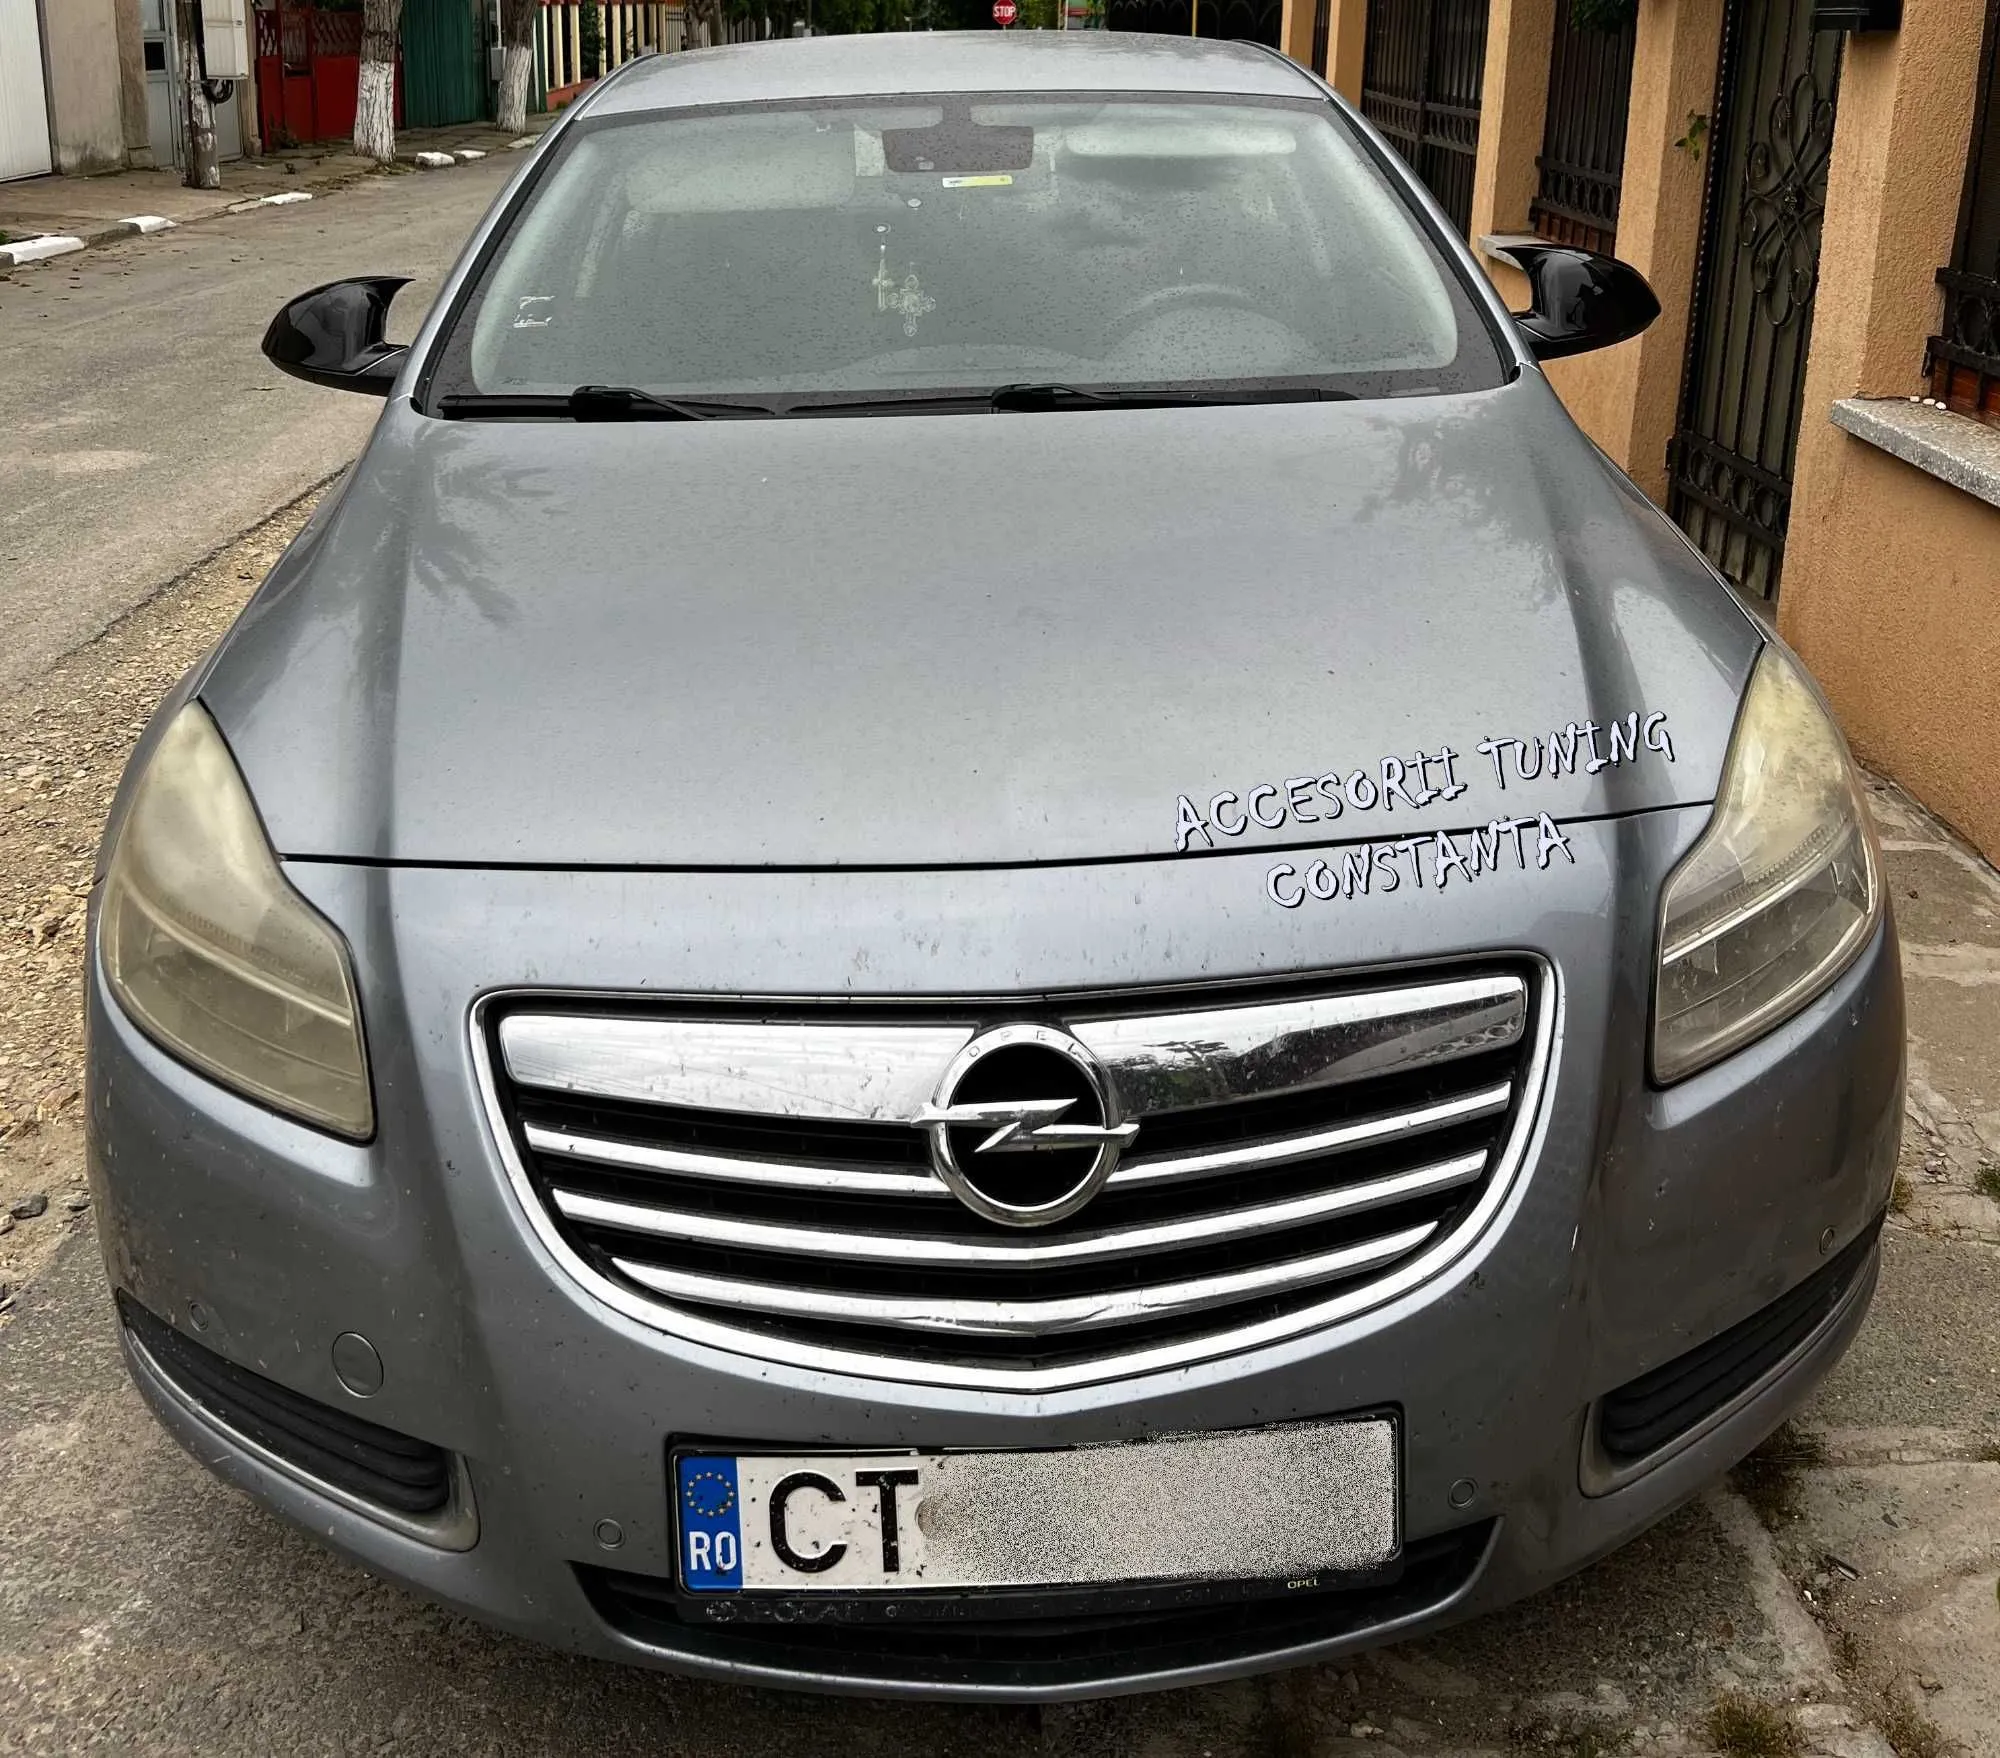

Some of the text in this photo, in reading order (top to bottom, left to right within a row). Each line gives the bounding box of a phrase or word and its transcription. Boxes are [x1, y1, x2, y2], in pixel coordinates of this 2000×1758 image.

[994, 6, 1016, 17] STOP
[969, 1030, 1080, 1057] OPEL
[769, 1469, 919, 1573] CT
[688, 1531, 737, 1571] RO
[1287, 1579, 1320, 1589] OPEL
